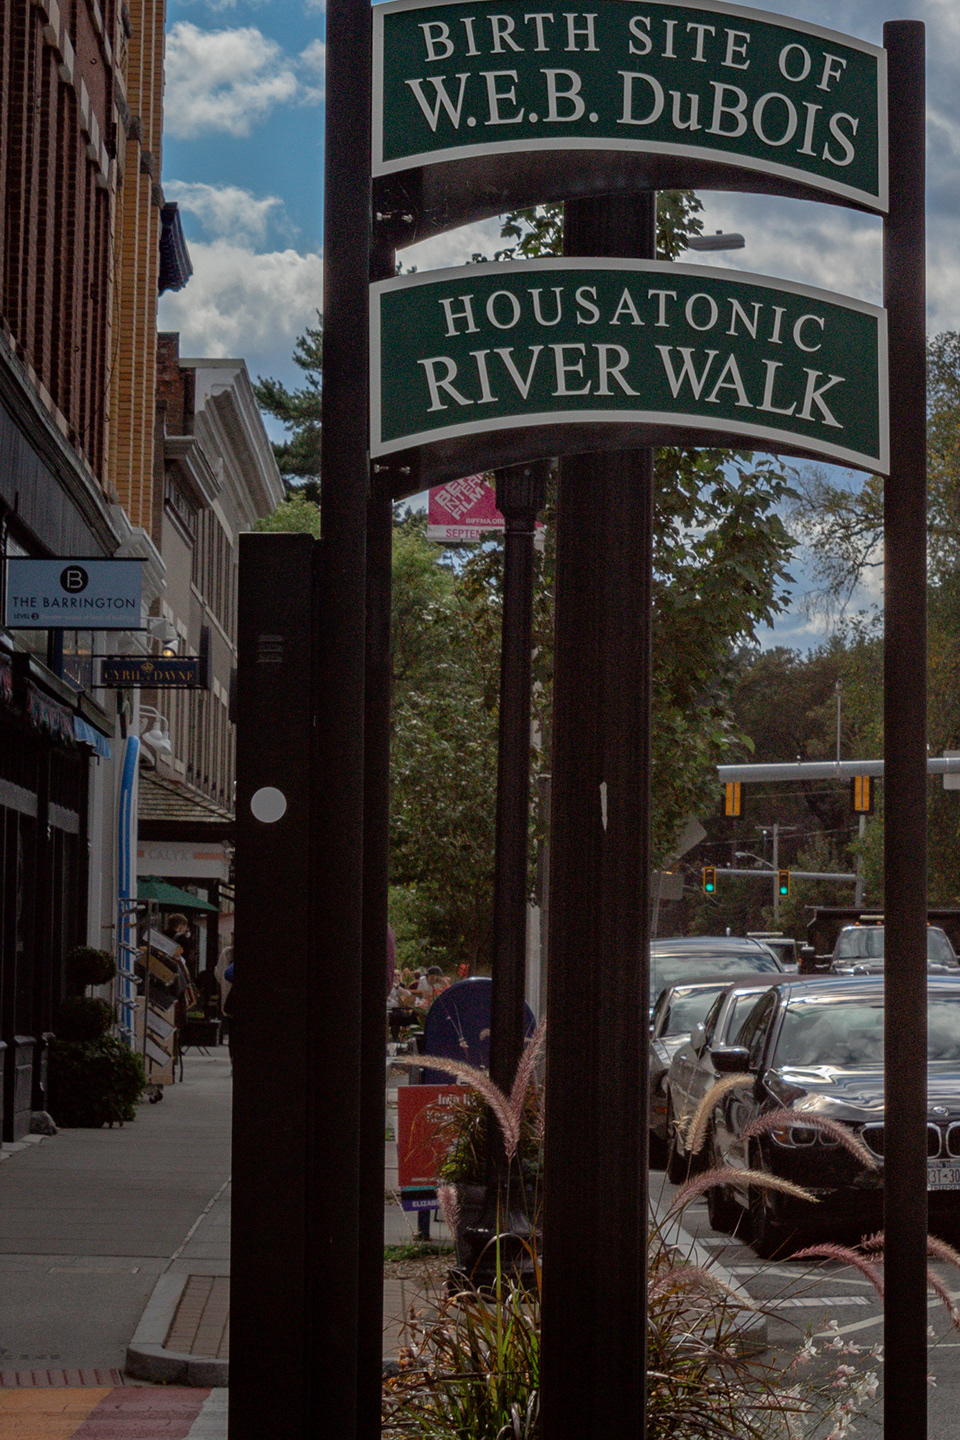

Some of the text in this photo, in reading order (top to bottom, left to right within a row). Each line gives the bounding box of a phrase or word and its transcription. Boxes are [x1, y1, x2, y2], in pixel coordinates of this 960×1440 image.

[418, 13, 848, 92] BIRTH SITE OF
[404, 68, 860, 166] W.E.B. DuBOIS
[438, 285, 826, 352] HOUSATONIC
[416, 342, 846, 429] RIVER WALK
[451, 486, 485, 520] FILM
[13, 597, 136, 609] THE BARRINGTON
[104, 669, 144, 681] CYRIL
